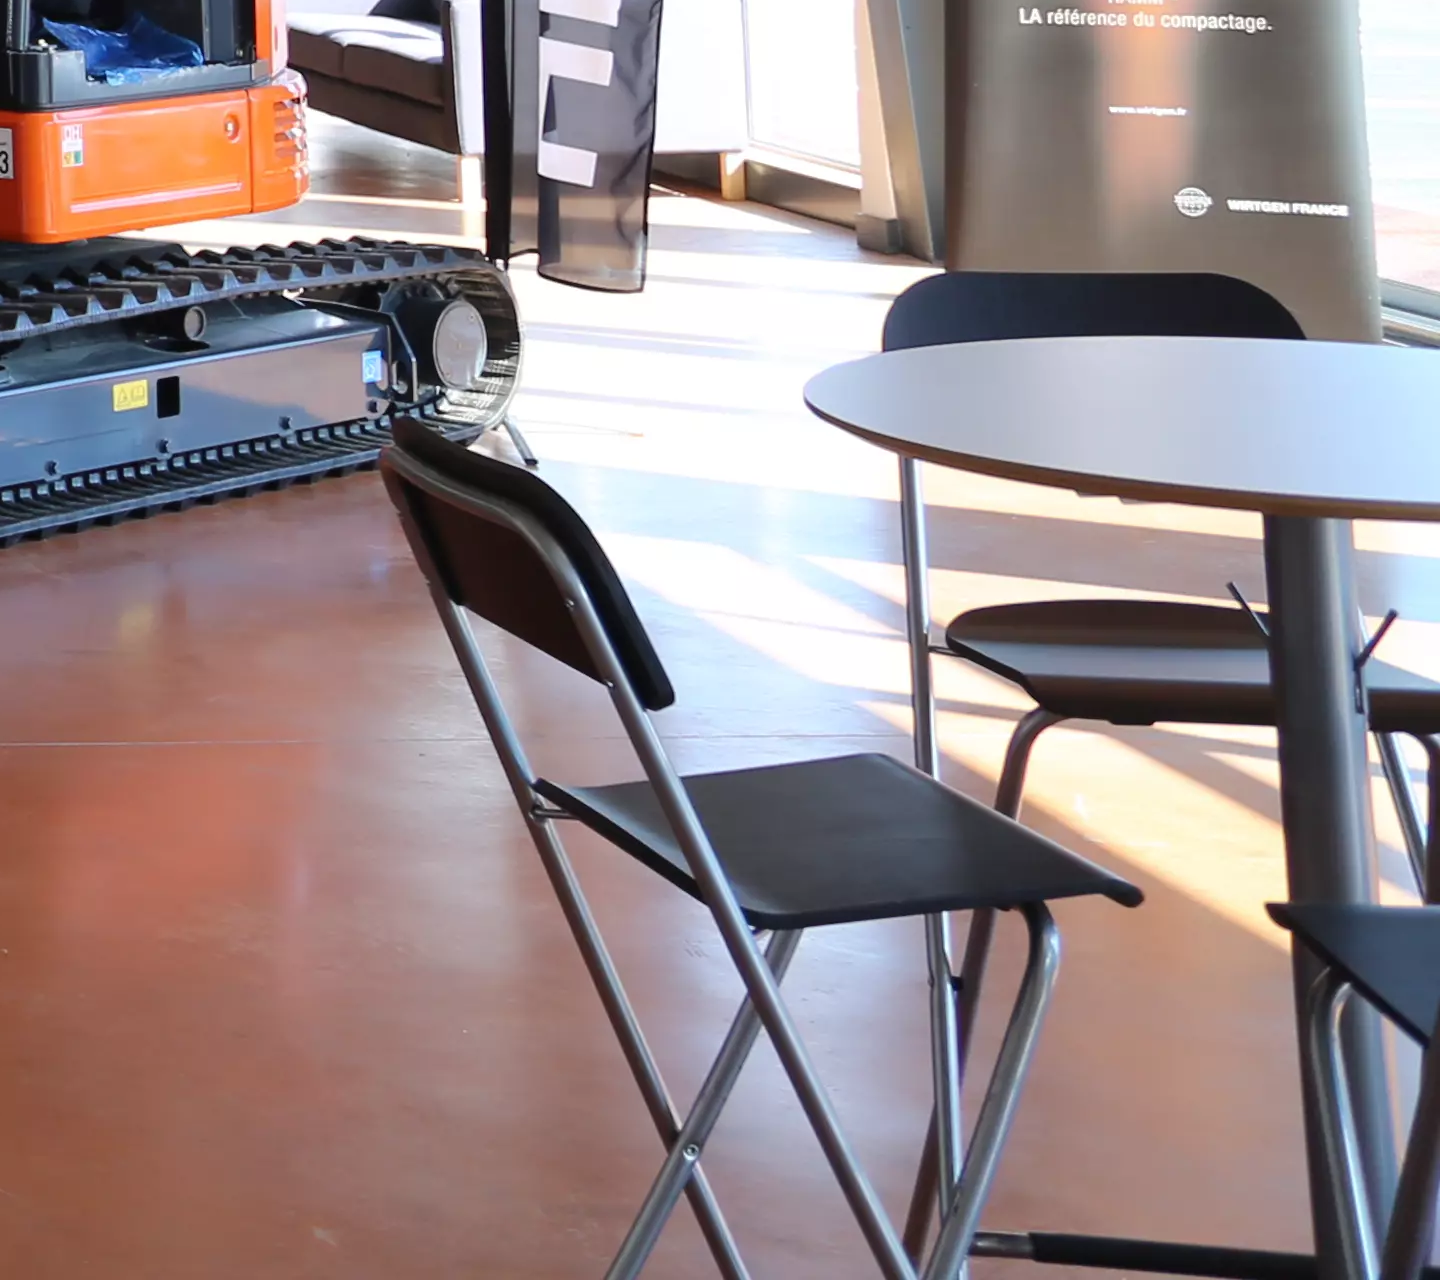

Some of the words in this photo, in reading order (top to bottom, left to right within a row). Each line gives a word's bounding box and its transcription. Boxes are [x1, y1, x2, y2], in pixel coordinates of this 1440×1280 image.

[1018, 7, 1042, 24] LA
[1047, 8, 1127, 27] référence
[1133, 11, 1155, 27] du
[1160, 12, 1273, 33] compactage.
[1226, 199, 1291, 214] WIRTGEN
[1292, 203, 1350, 217] FRANCE
